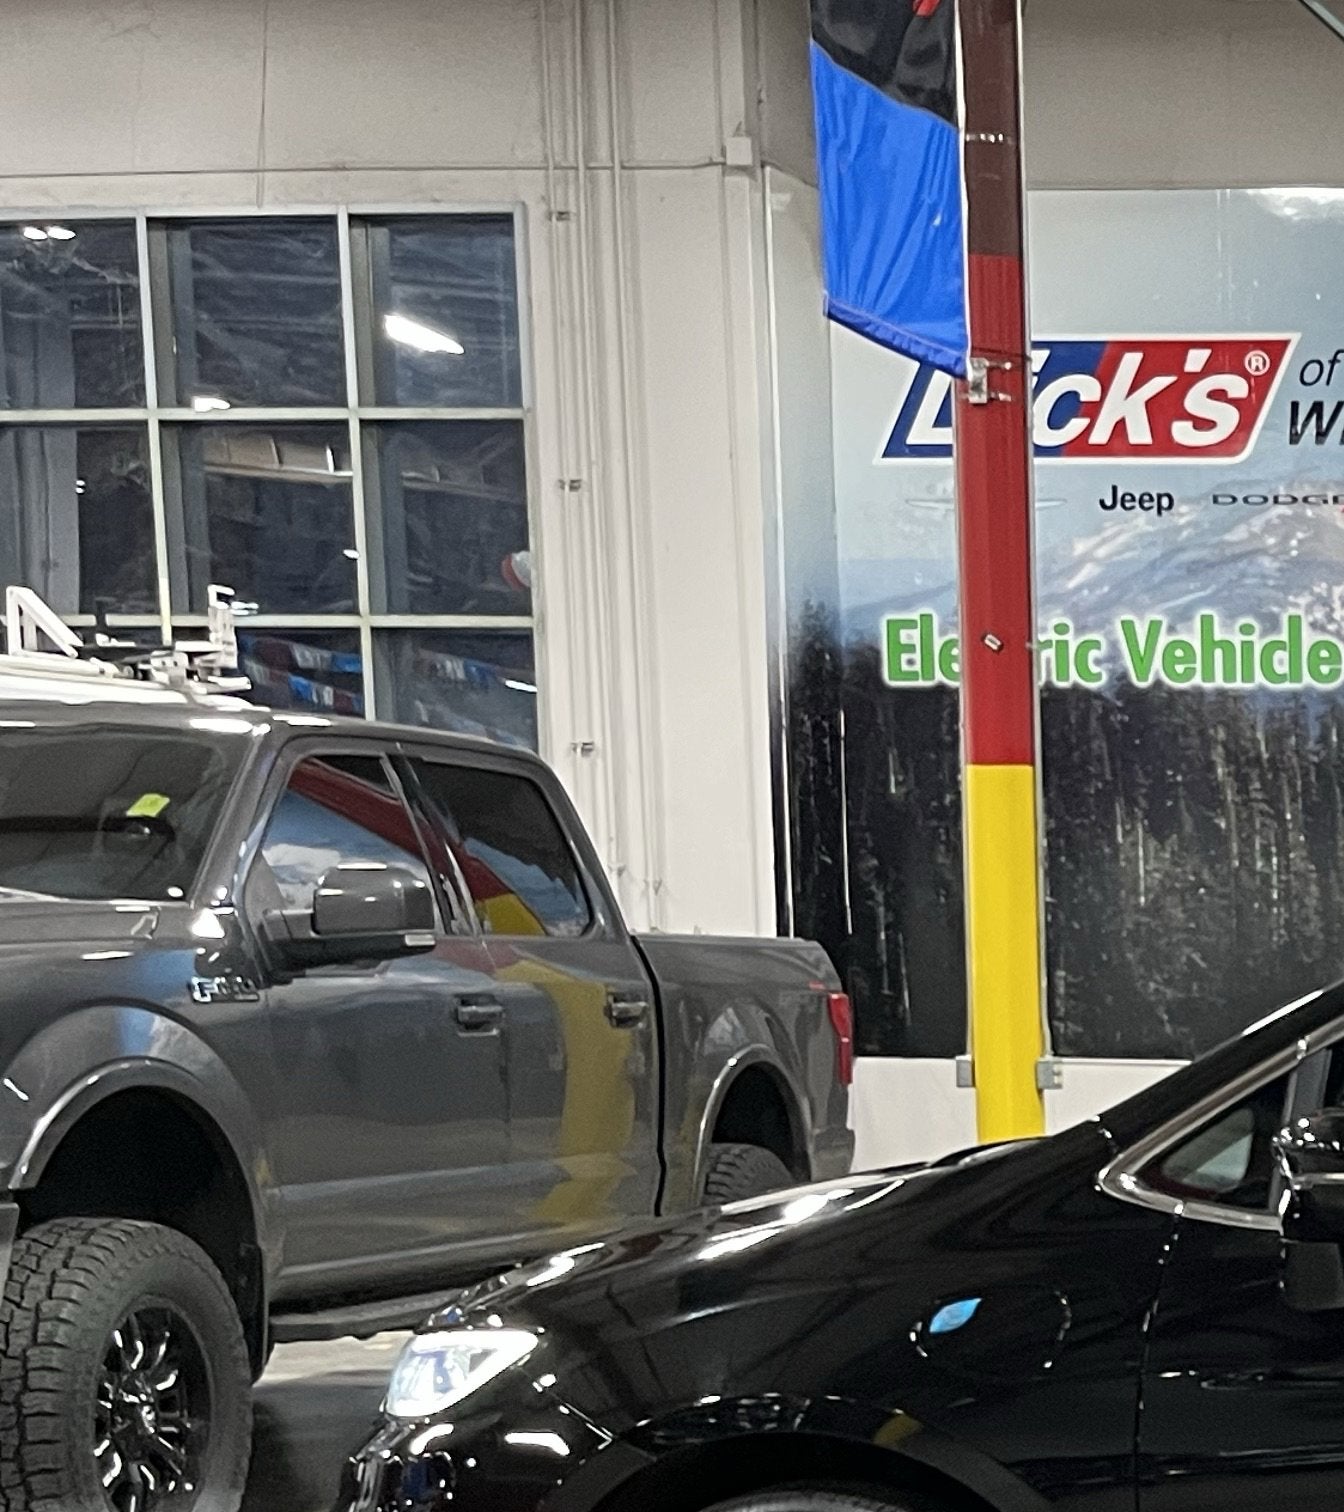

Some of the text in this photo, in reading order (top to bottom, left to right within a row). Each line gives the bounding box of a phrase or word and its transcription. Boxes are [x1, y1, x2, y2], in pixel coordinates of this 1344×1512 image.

[1099, 485, 1175, 516] Jeep
[886, 613, 1103, 684] Eleic
[1120, 613, 1343, 685] Vehicle
